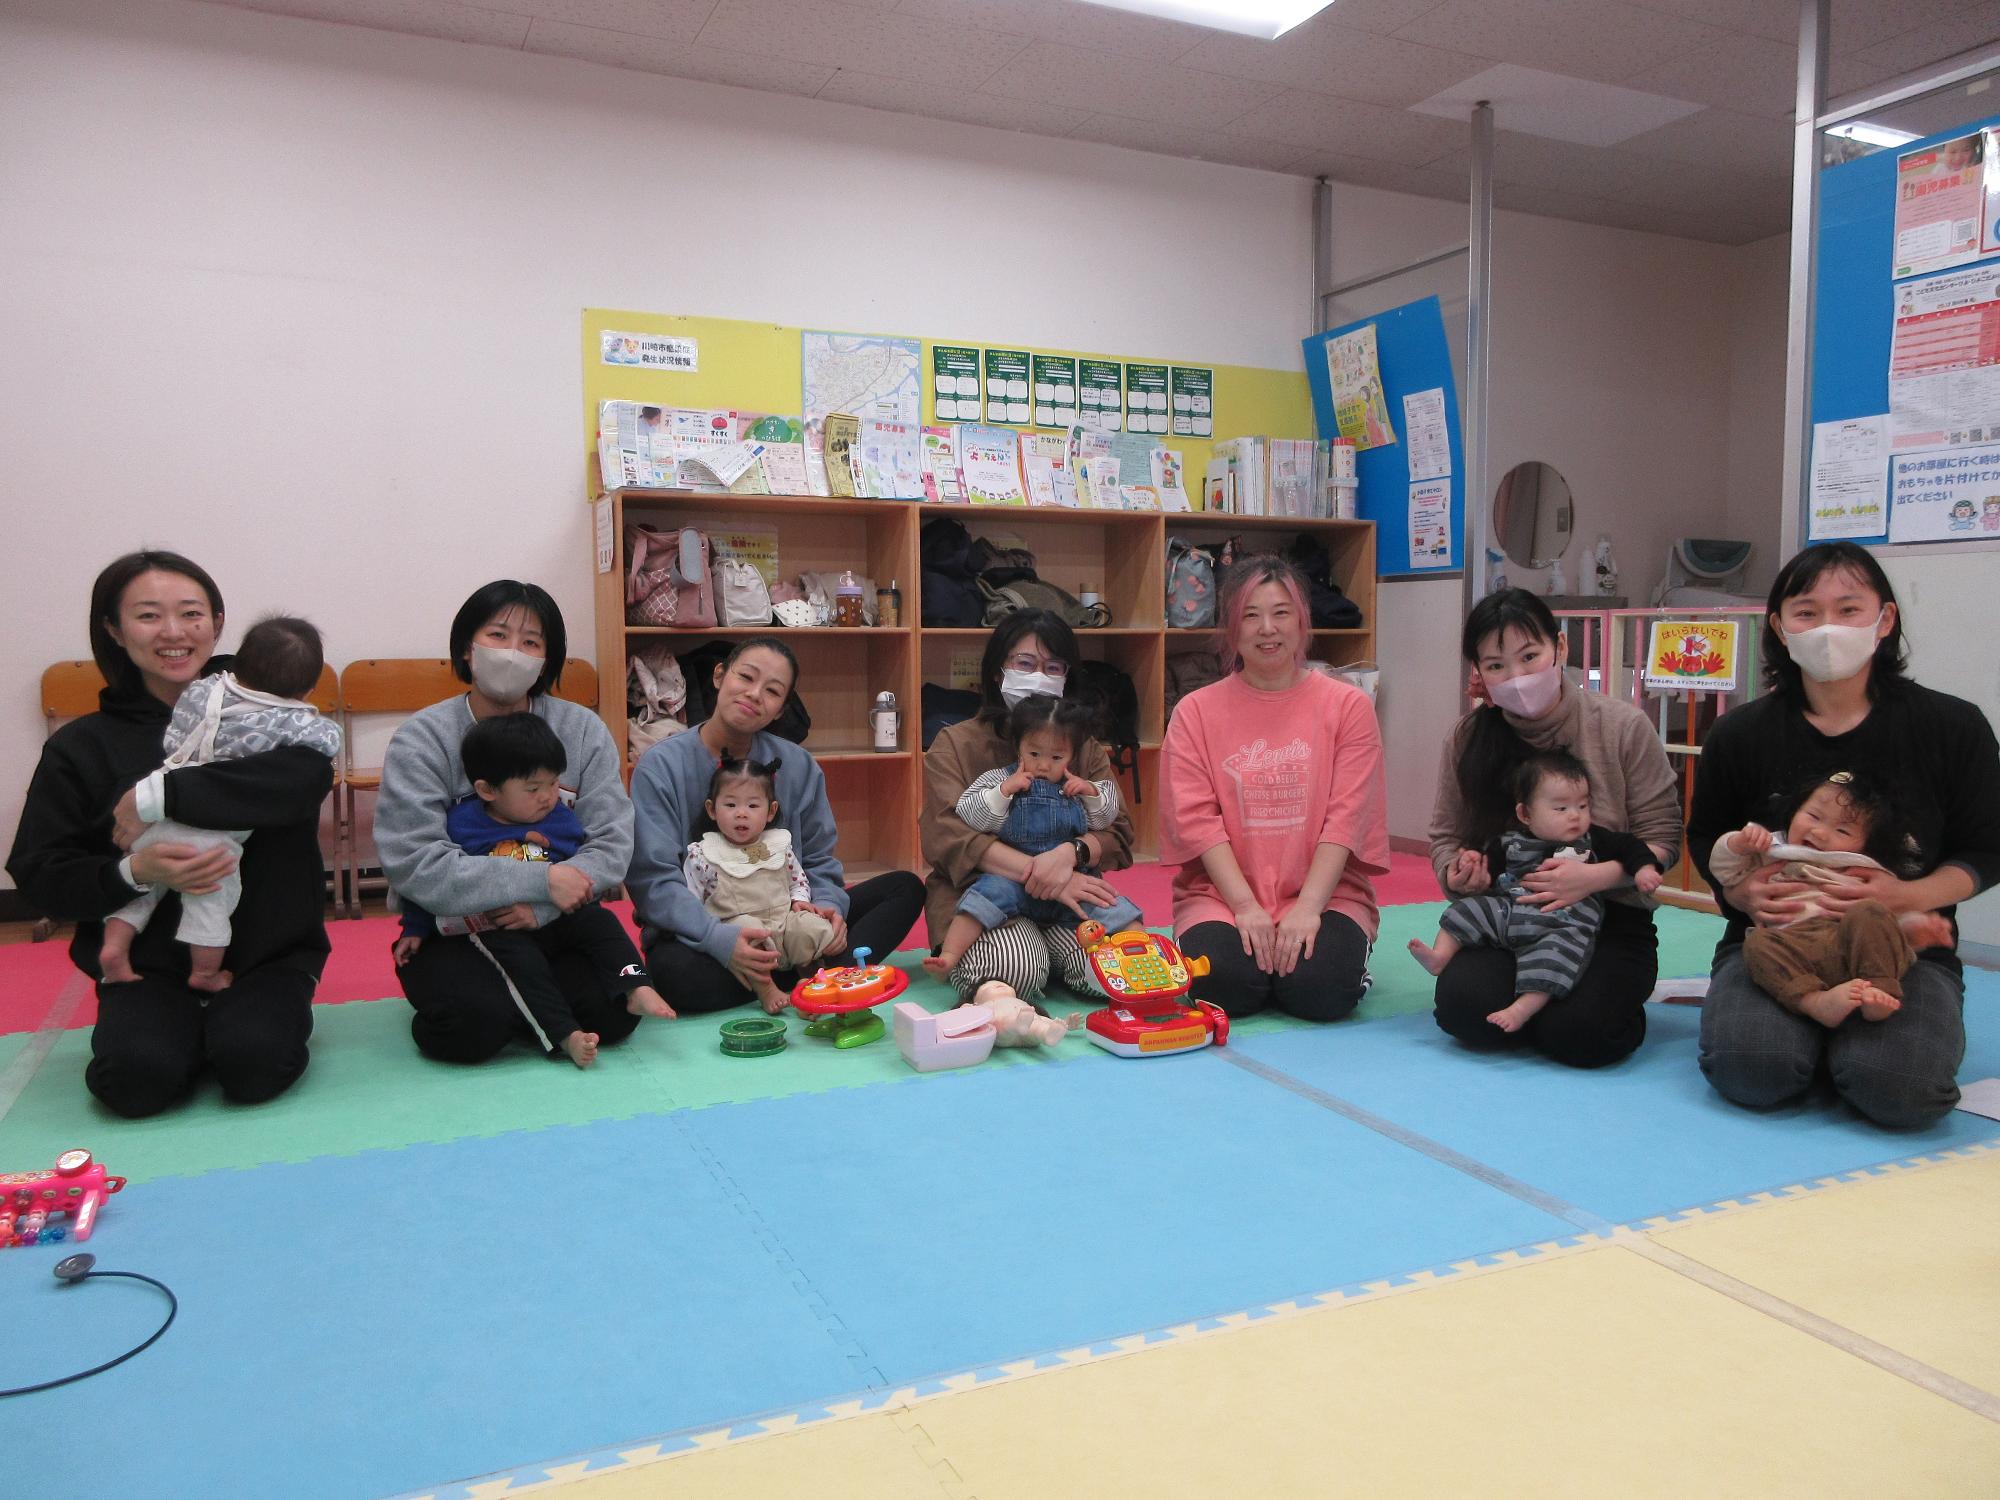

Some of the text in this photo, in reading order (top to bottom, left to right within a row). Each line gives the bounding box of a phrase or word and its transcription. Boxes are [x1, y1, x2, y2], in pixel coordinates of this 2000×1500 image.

[1897, 491, 1953, 505] 出てください
[1661, 626, 1728, 640] はいらないでね
